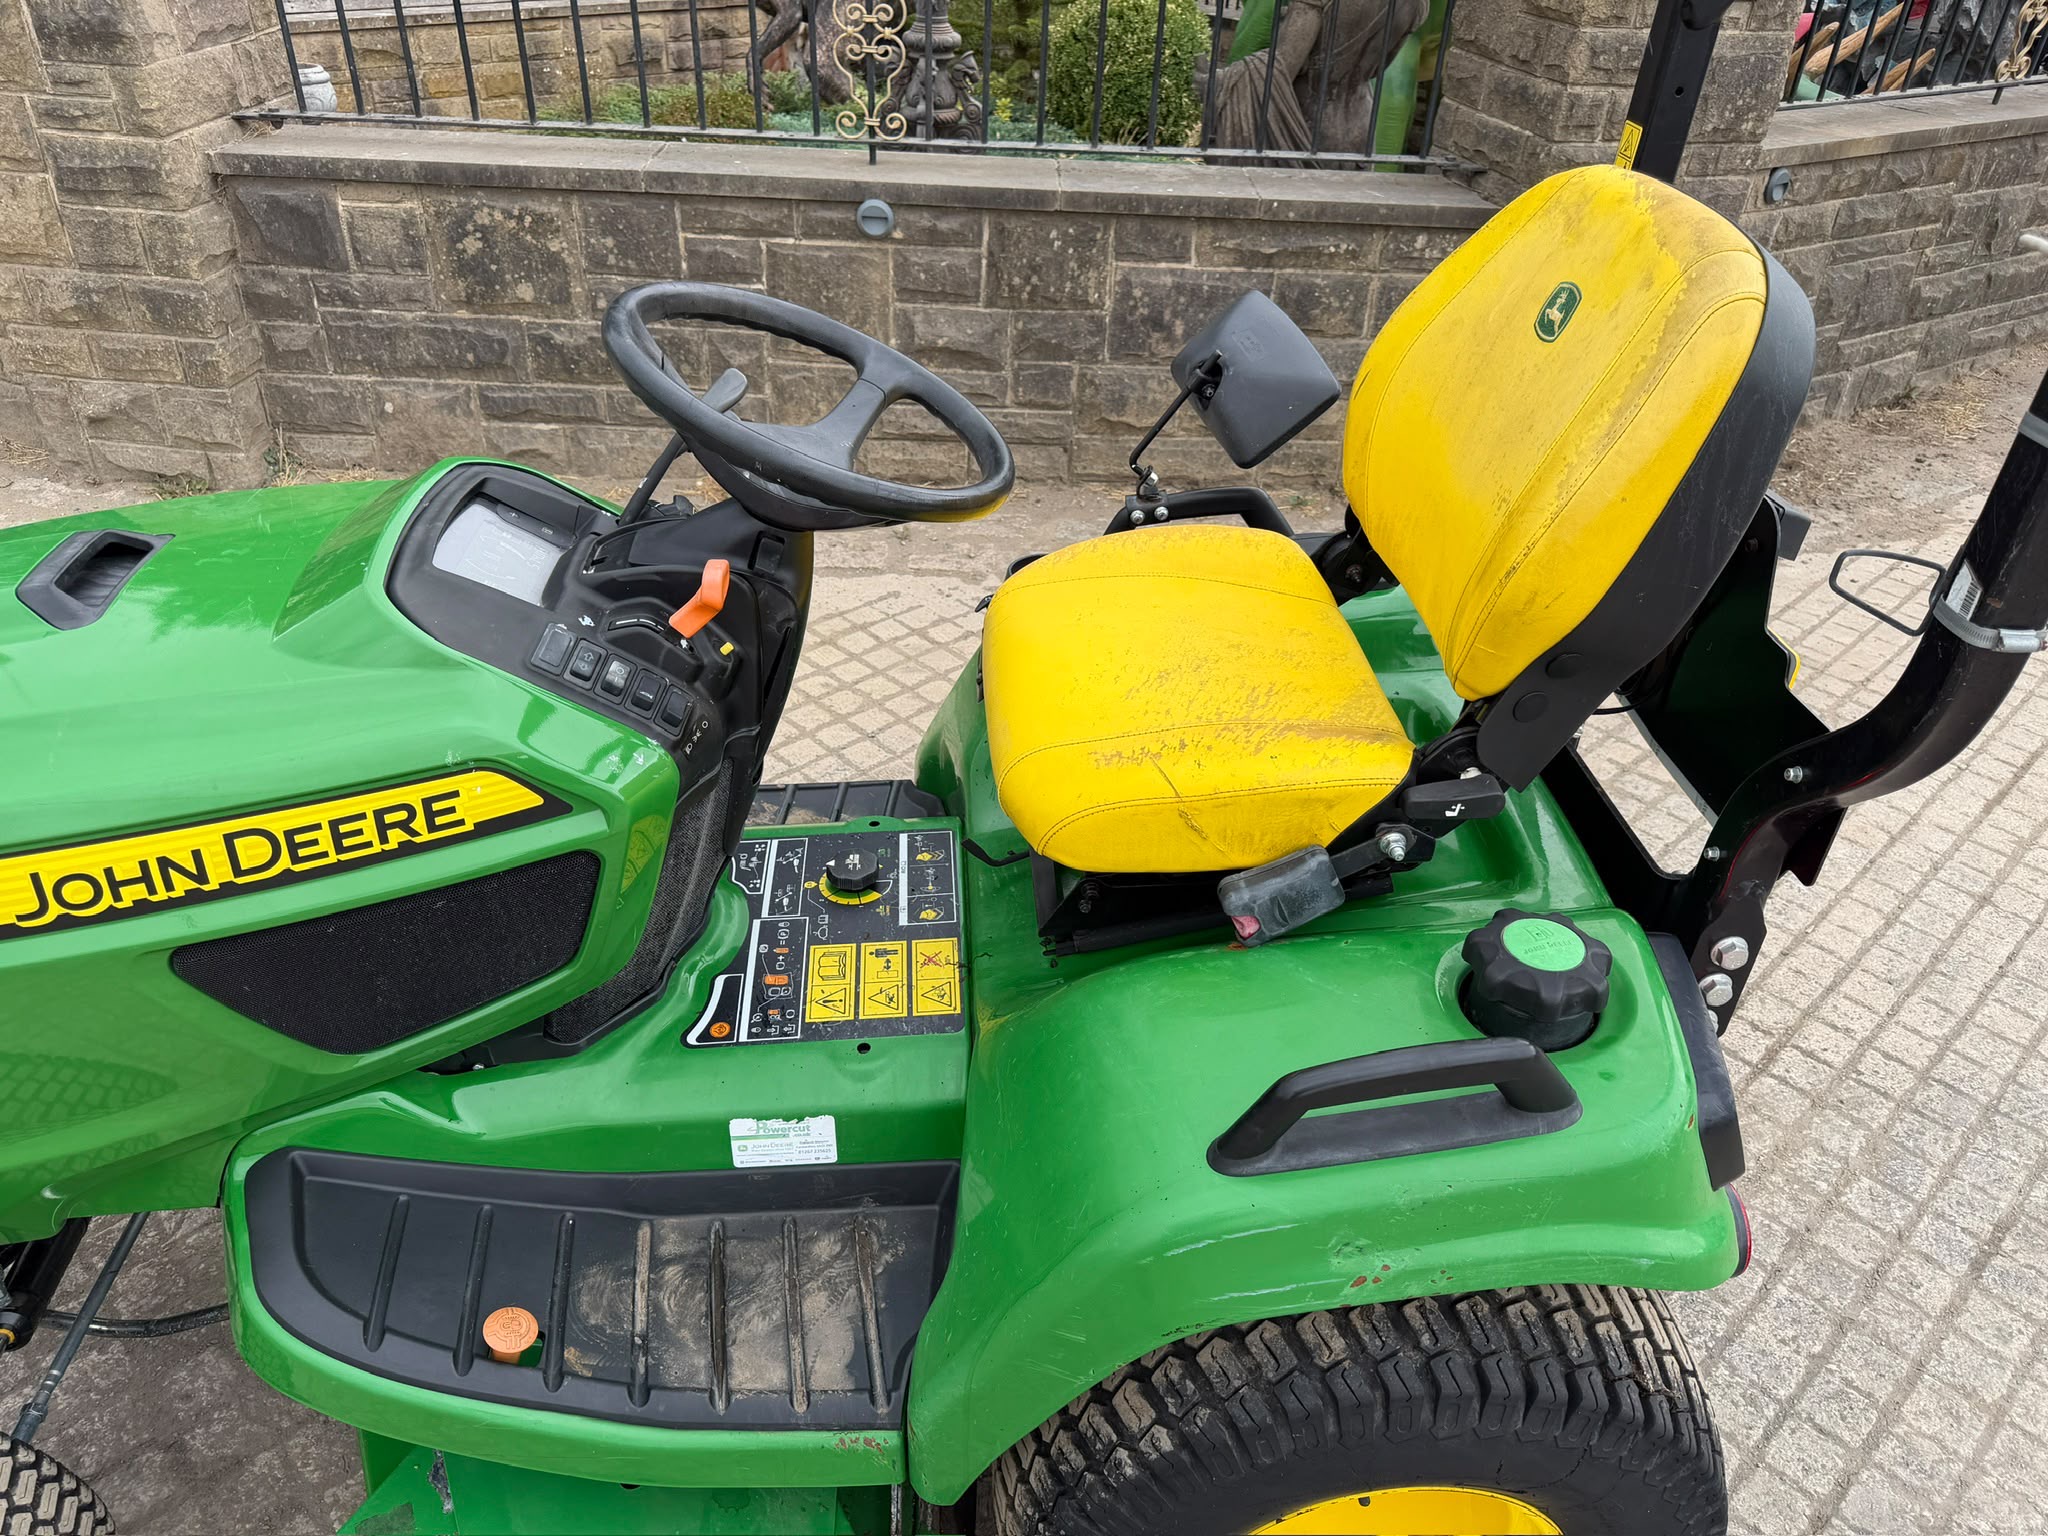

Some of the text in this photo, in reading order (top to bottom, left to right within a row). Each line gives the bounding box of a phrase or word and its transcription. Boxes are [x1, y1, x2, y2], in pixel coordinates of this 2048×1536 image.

[15, 789, 466, 924] JOHN DEERE
[756, 1121, 811, 1134] Powercut
